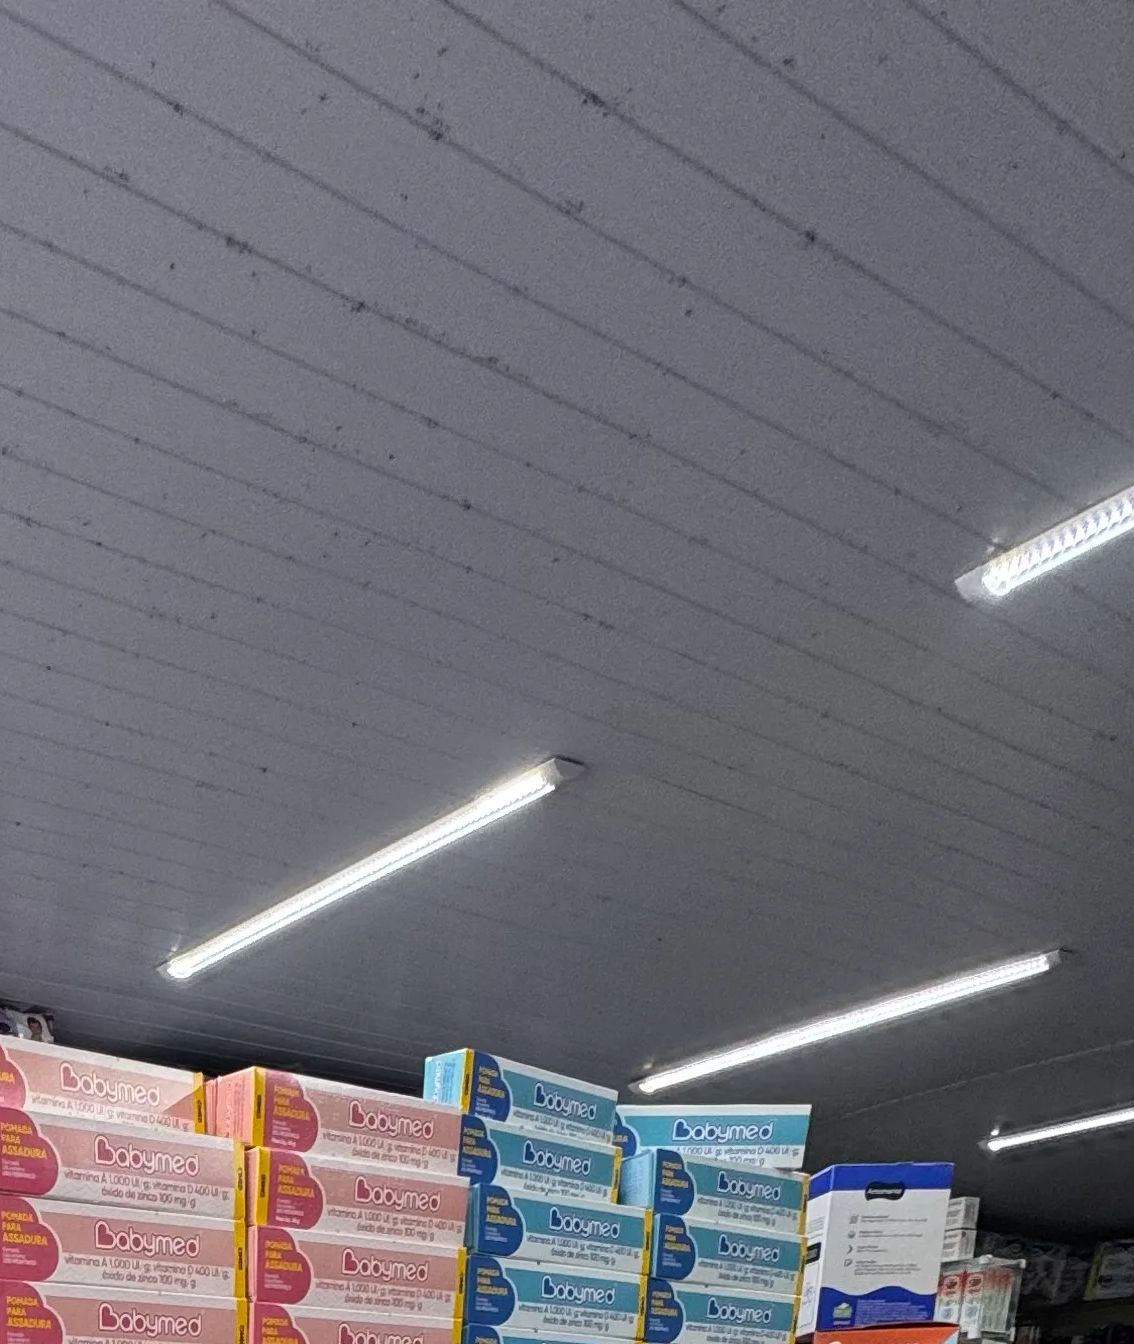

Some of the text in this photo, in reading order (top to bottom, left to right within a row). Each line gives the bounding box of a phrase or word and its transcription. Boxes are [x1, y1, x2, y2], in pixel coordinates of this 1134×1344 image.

[60, 1063, 160, 1106] Babymed
[534, 1083, 597, 1120] Babymed
[348, 1101, 434, 1139] Babymed
[672, 1120, 774, 1142] Babymed
[94, 1135, 199, 1175] Babymed
[94, 1220, 200, 1257] Babymed
[549, 1207, 620, 1239] Babymed
[99, 1302, 202, 1337] Babymed
